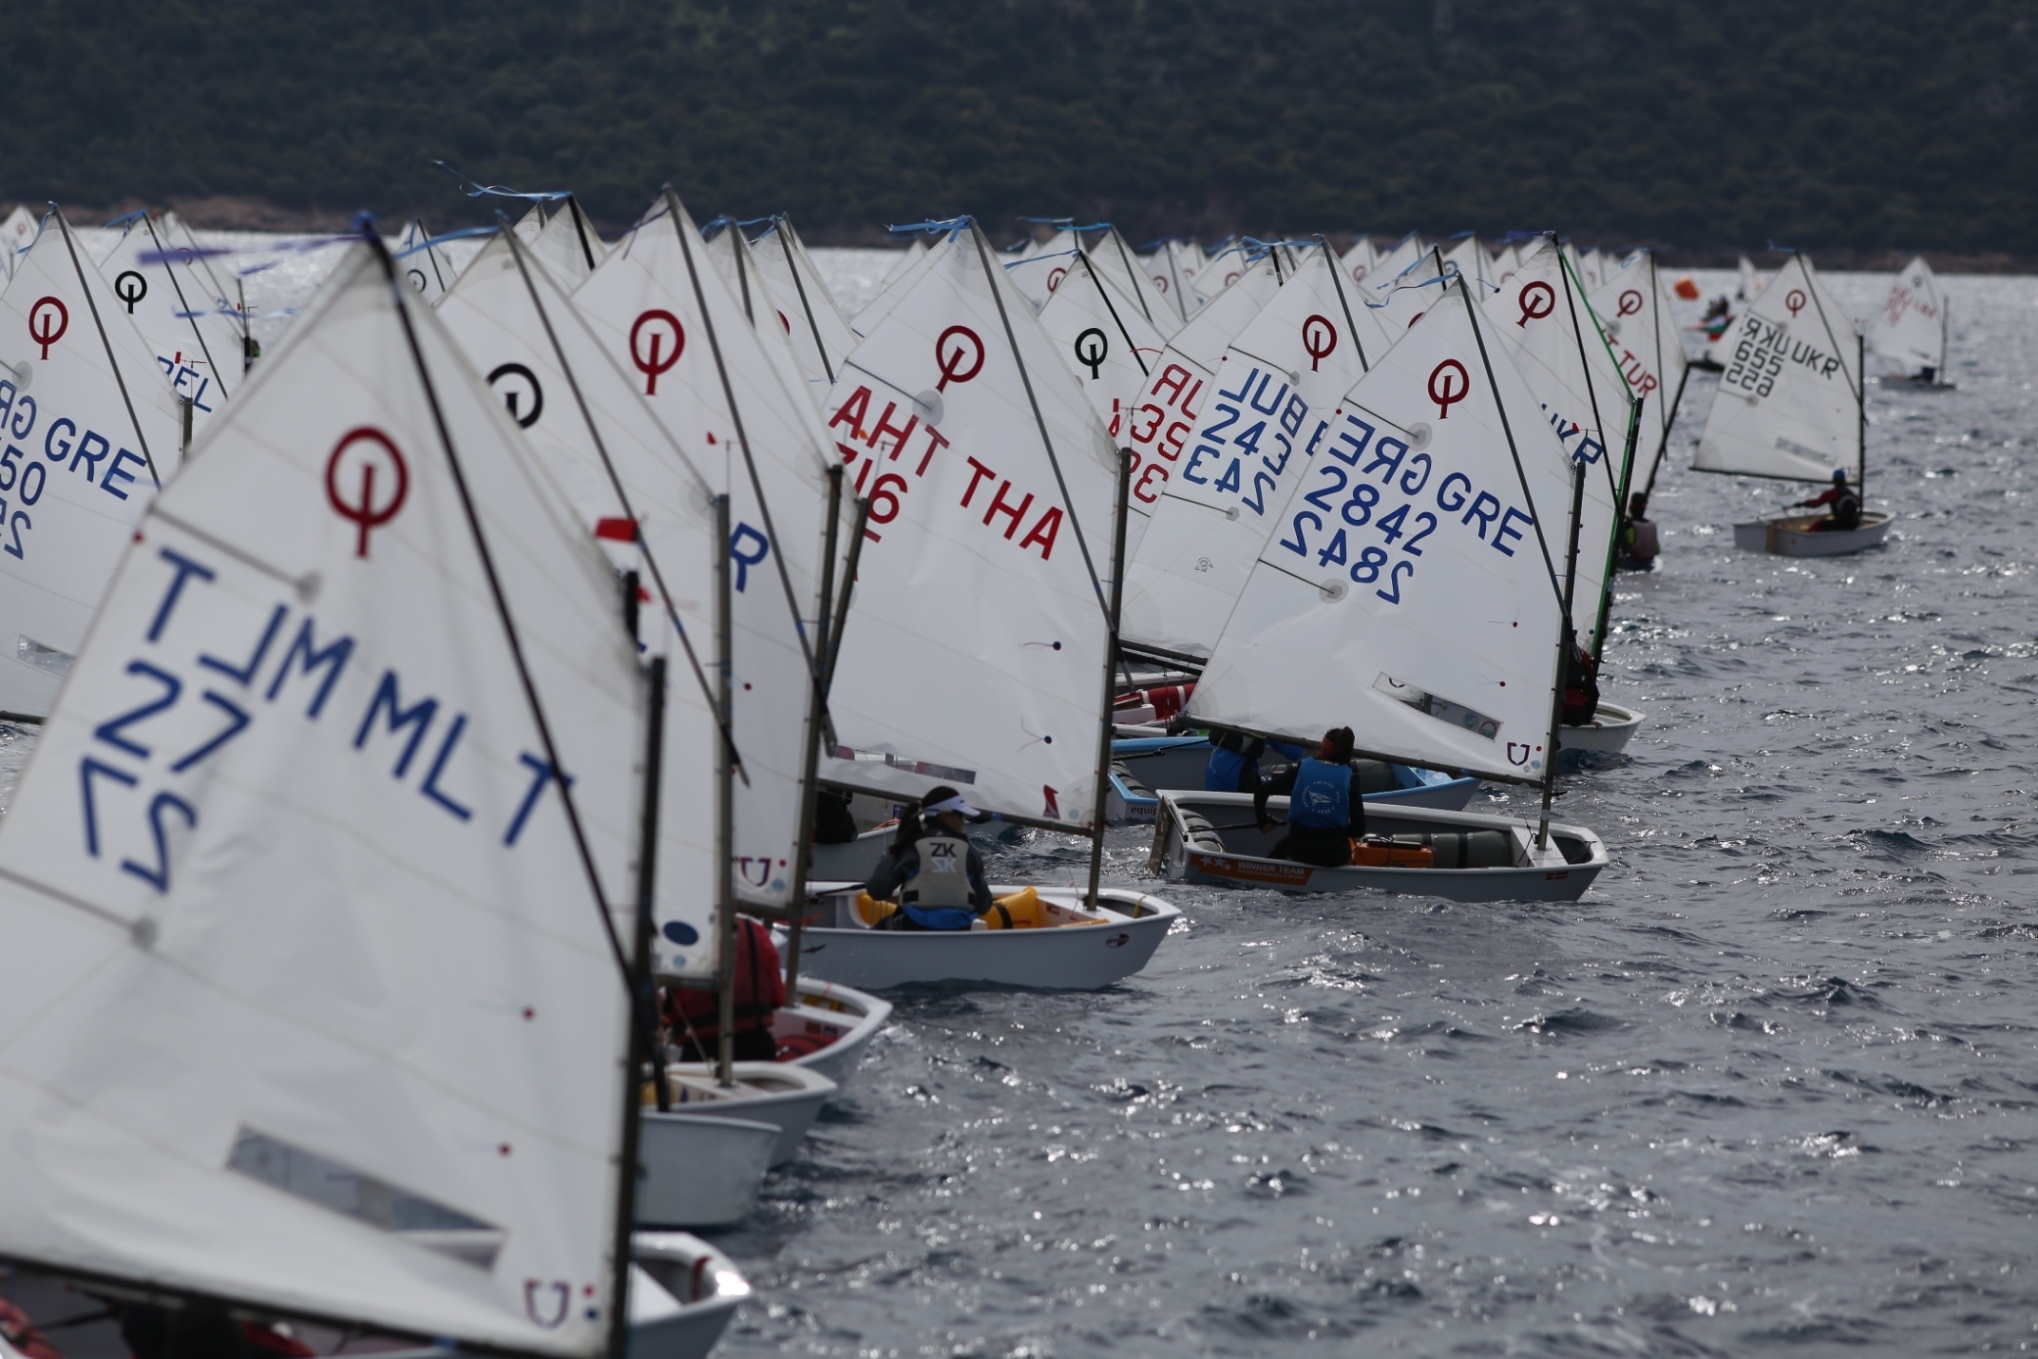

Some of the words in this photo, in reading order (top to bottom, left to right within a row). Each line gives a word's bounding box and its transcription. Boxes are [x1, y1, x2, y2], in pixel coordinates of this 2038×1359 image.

[1618, 349, 1658, 398] TUR
[1735, 340, 1784, 377] 655
[1791, 340, 1840, 380] UKR
[44, 417, 148, 501] GRE
[960, 455, 1064, 561] THA
[1303, 466, 1438, 557] 2842
[1436, 472, 1535, 558] GRE
[94, 659, 252, 775] 27
[353, 668, 576, 848] MLT
[929, 842, 957, 857] ZK
[1237, 861, 1276, 873] WINNER
[1279, 866, 1305, 876] TEAM
